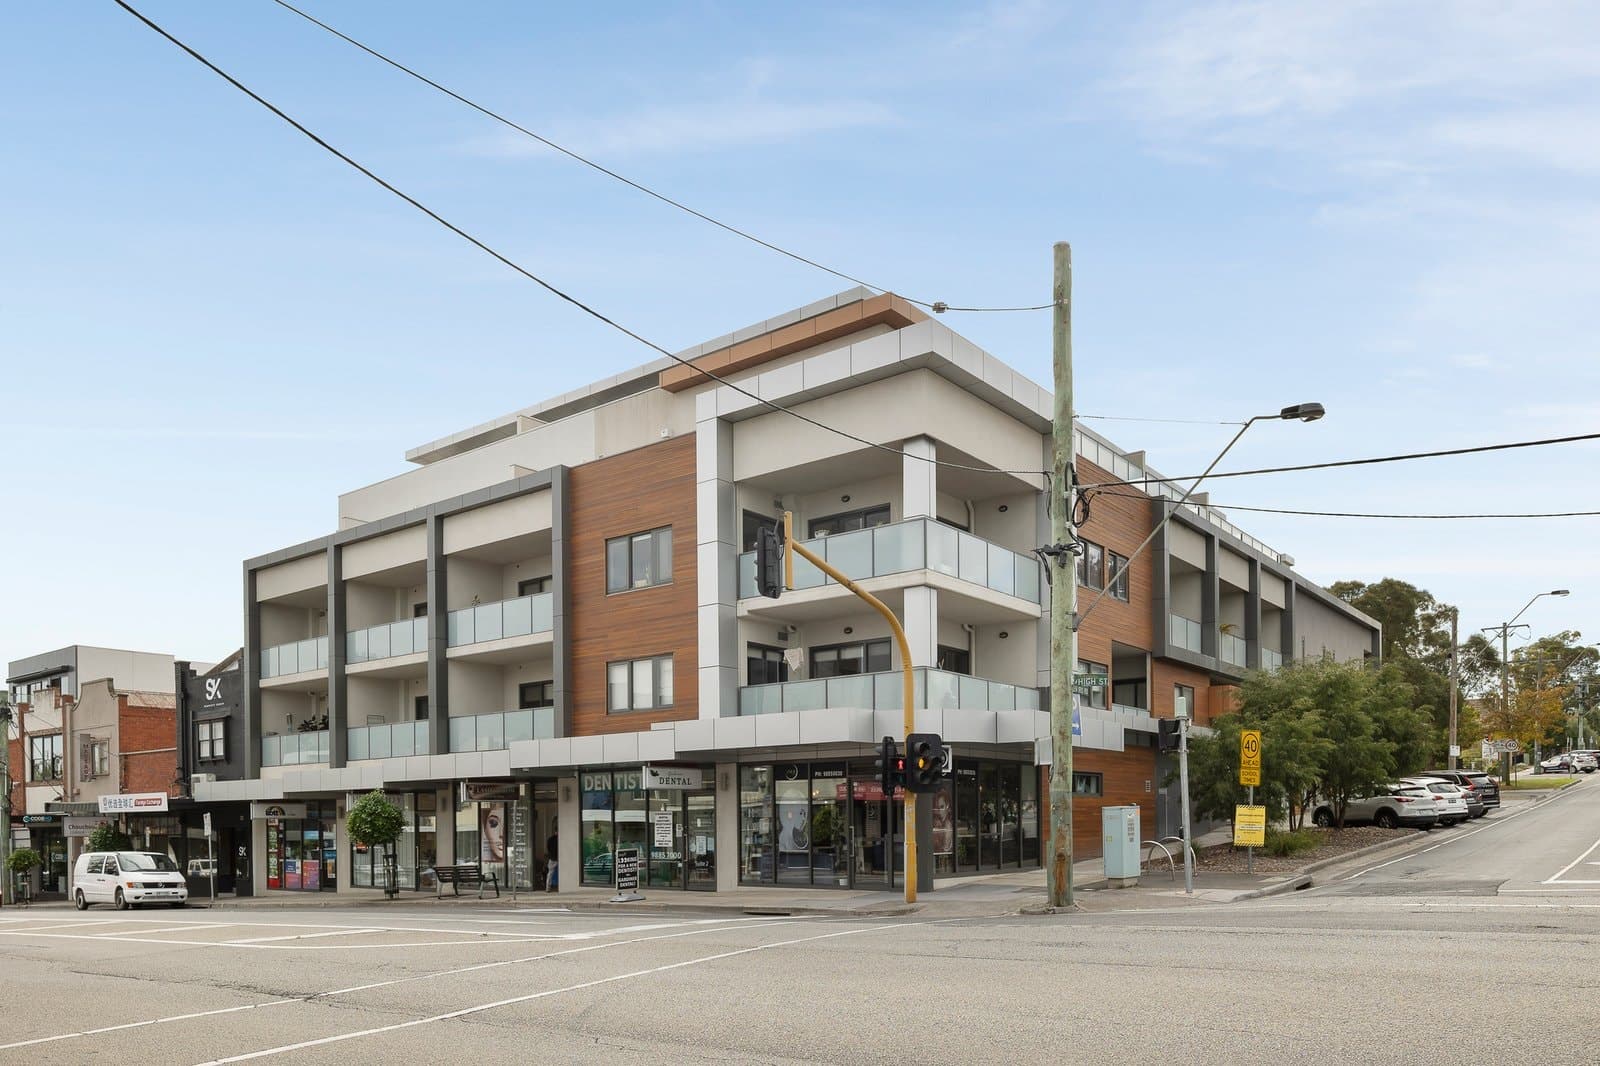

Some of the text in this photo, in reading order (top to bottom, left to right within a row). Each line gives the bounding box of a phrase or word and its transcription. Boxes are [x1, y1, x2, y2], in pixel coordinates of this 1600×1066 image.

[1079, 677, 1108, 687] HIGH ST
[1244, 739, 1257, 752] 40
[659, 777, 692, 785] DENTAL
